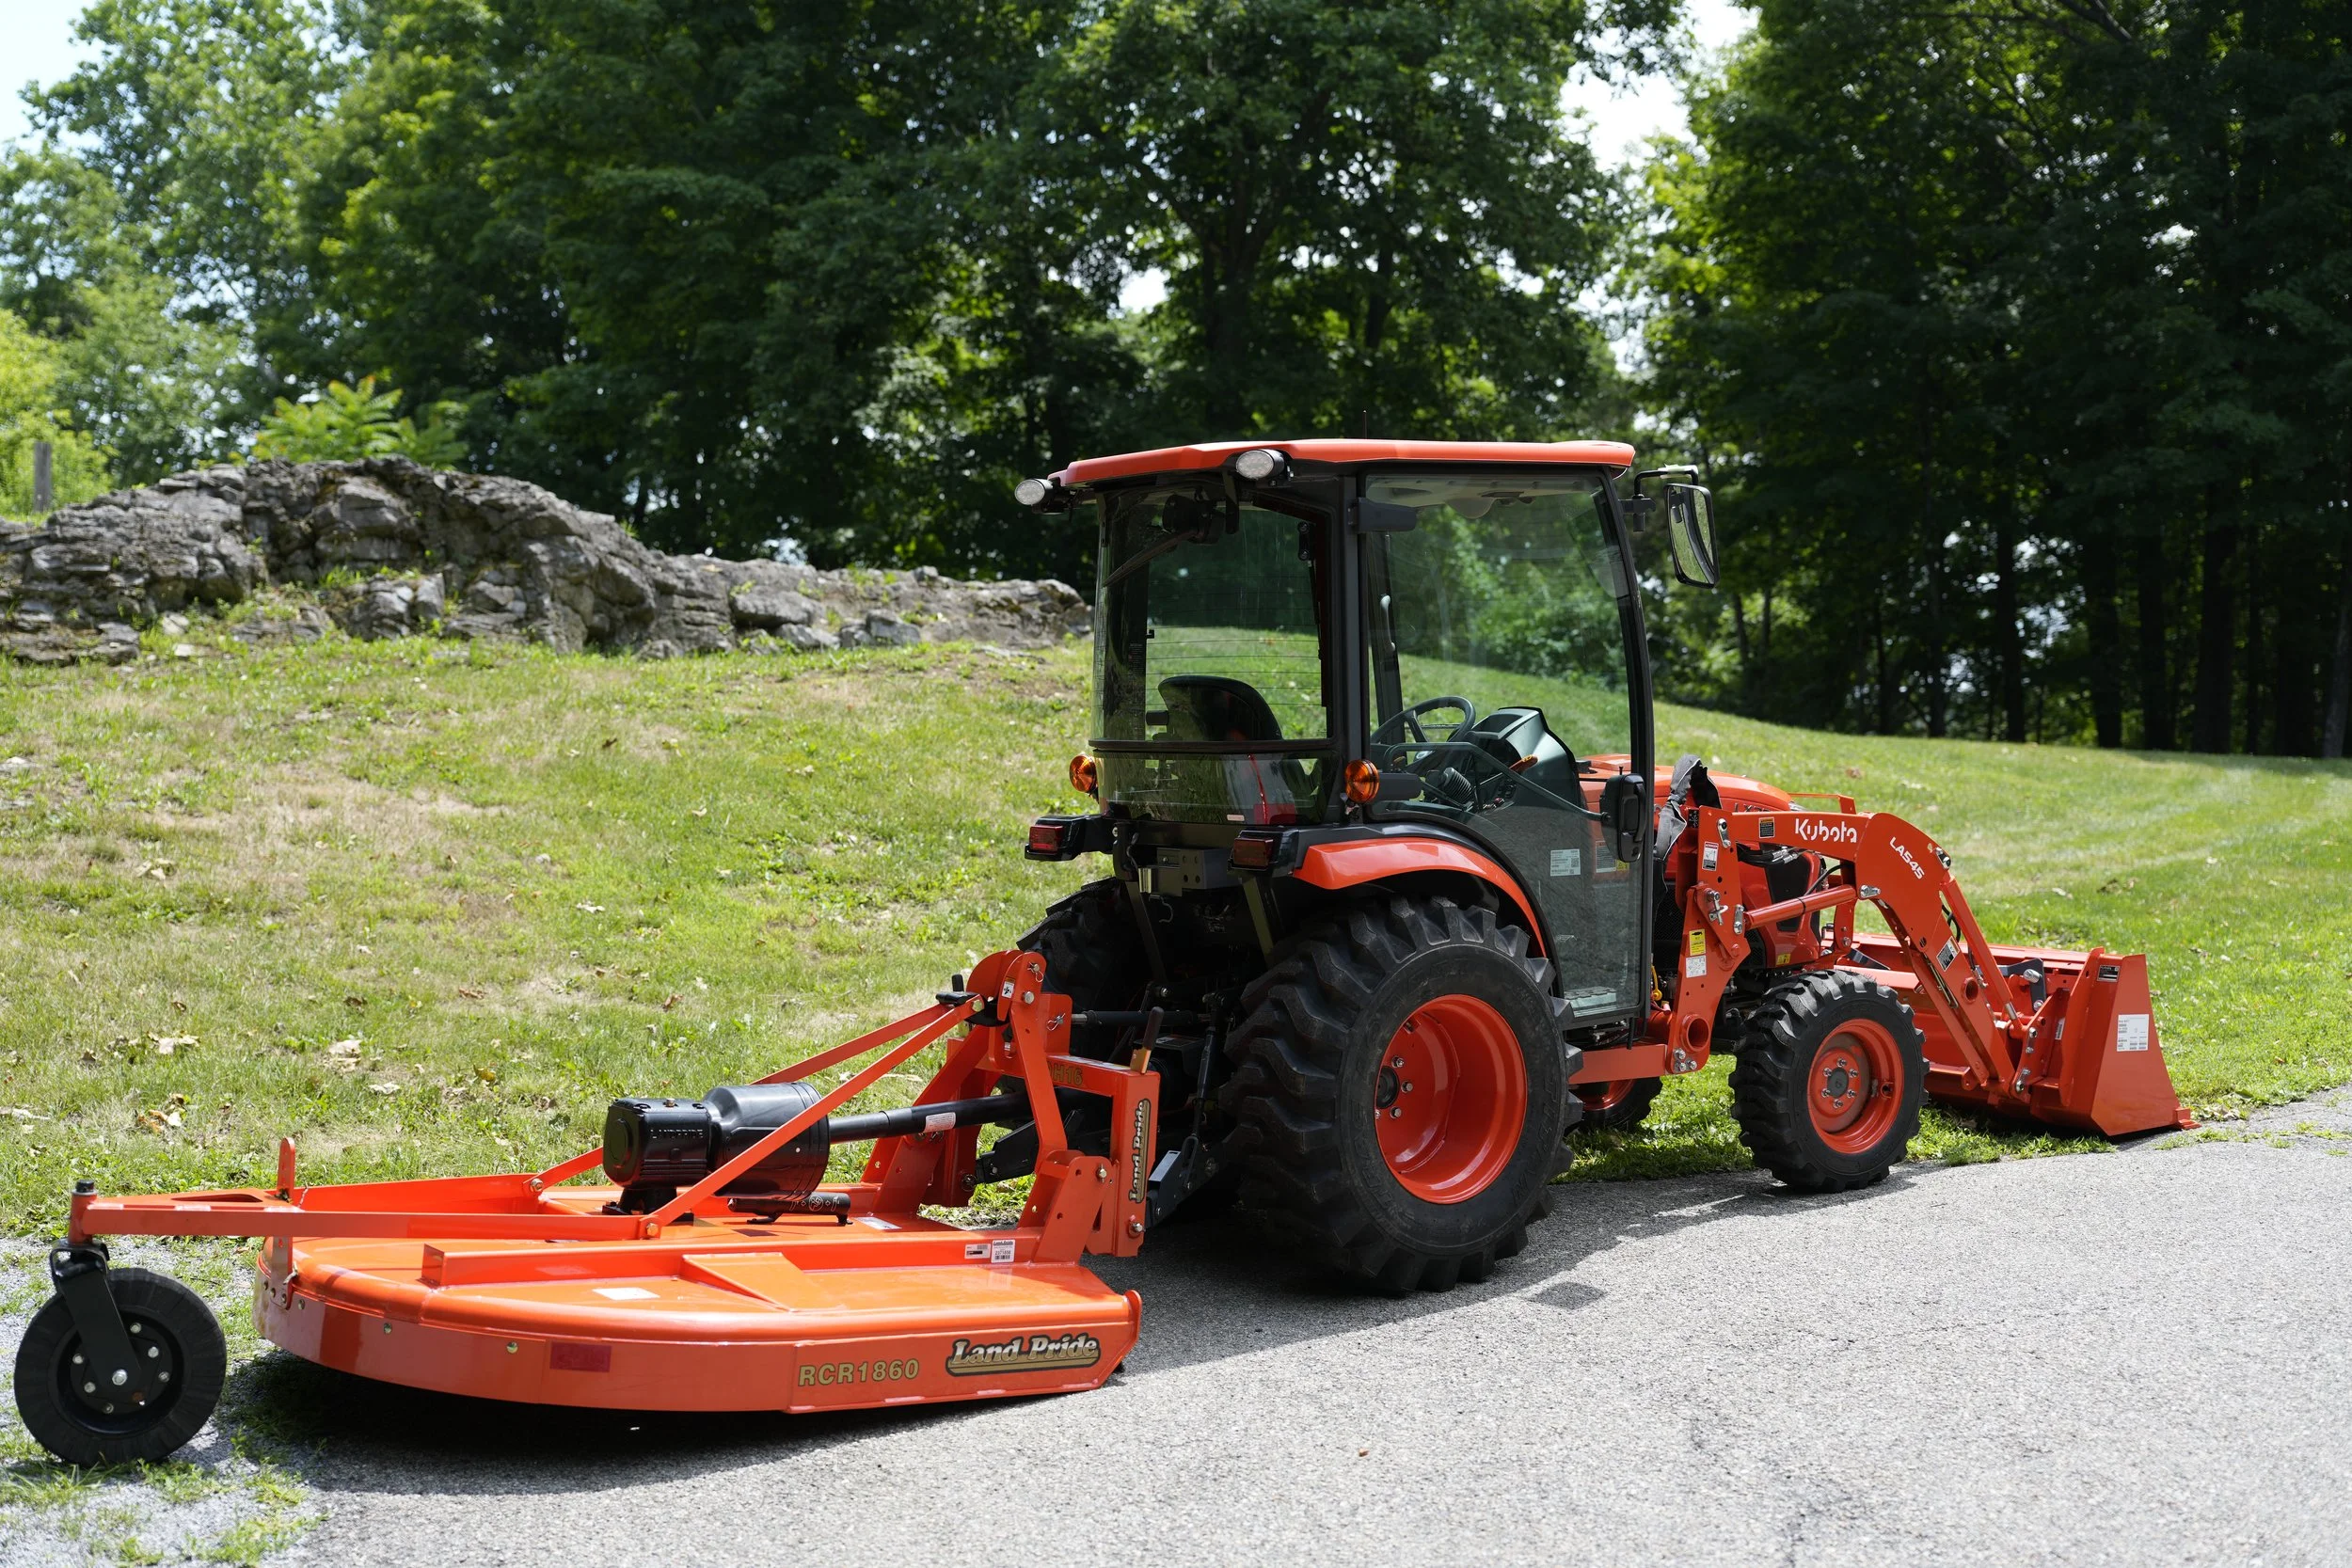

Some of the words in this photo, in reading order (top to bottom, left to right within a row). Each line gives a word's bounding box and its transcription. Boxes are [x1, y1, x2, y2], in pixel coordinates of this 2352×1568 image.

[1794, 817, 1857, 843] Kubota
[1889, 836, 1925, 879] LA545
[1048, 1062, 1083, 1085] H16
[1132, 1100, 1146, 1148] Pride
[1129, 1154, 1143, 1203] Land
[949, 1337, 1021, 1365] Land
[1026, 1333, 1099, 1361] Pride
[798, 1358, 920, 1386] RCR1860
